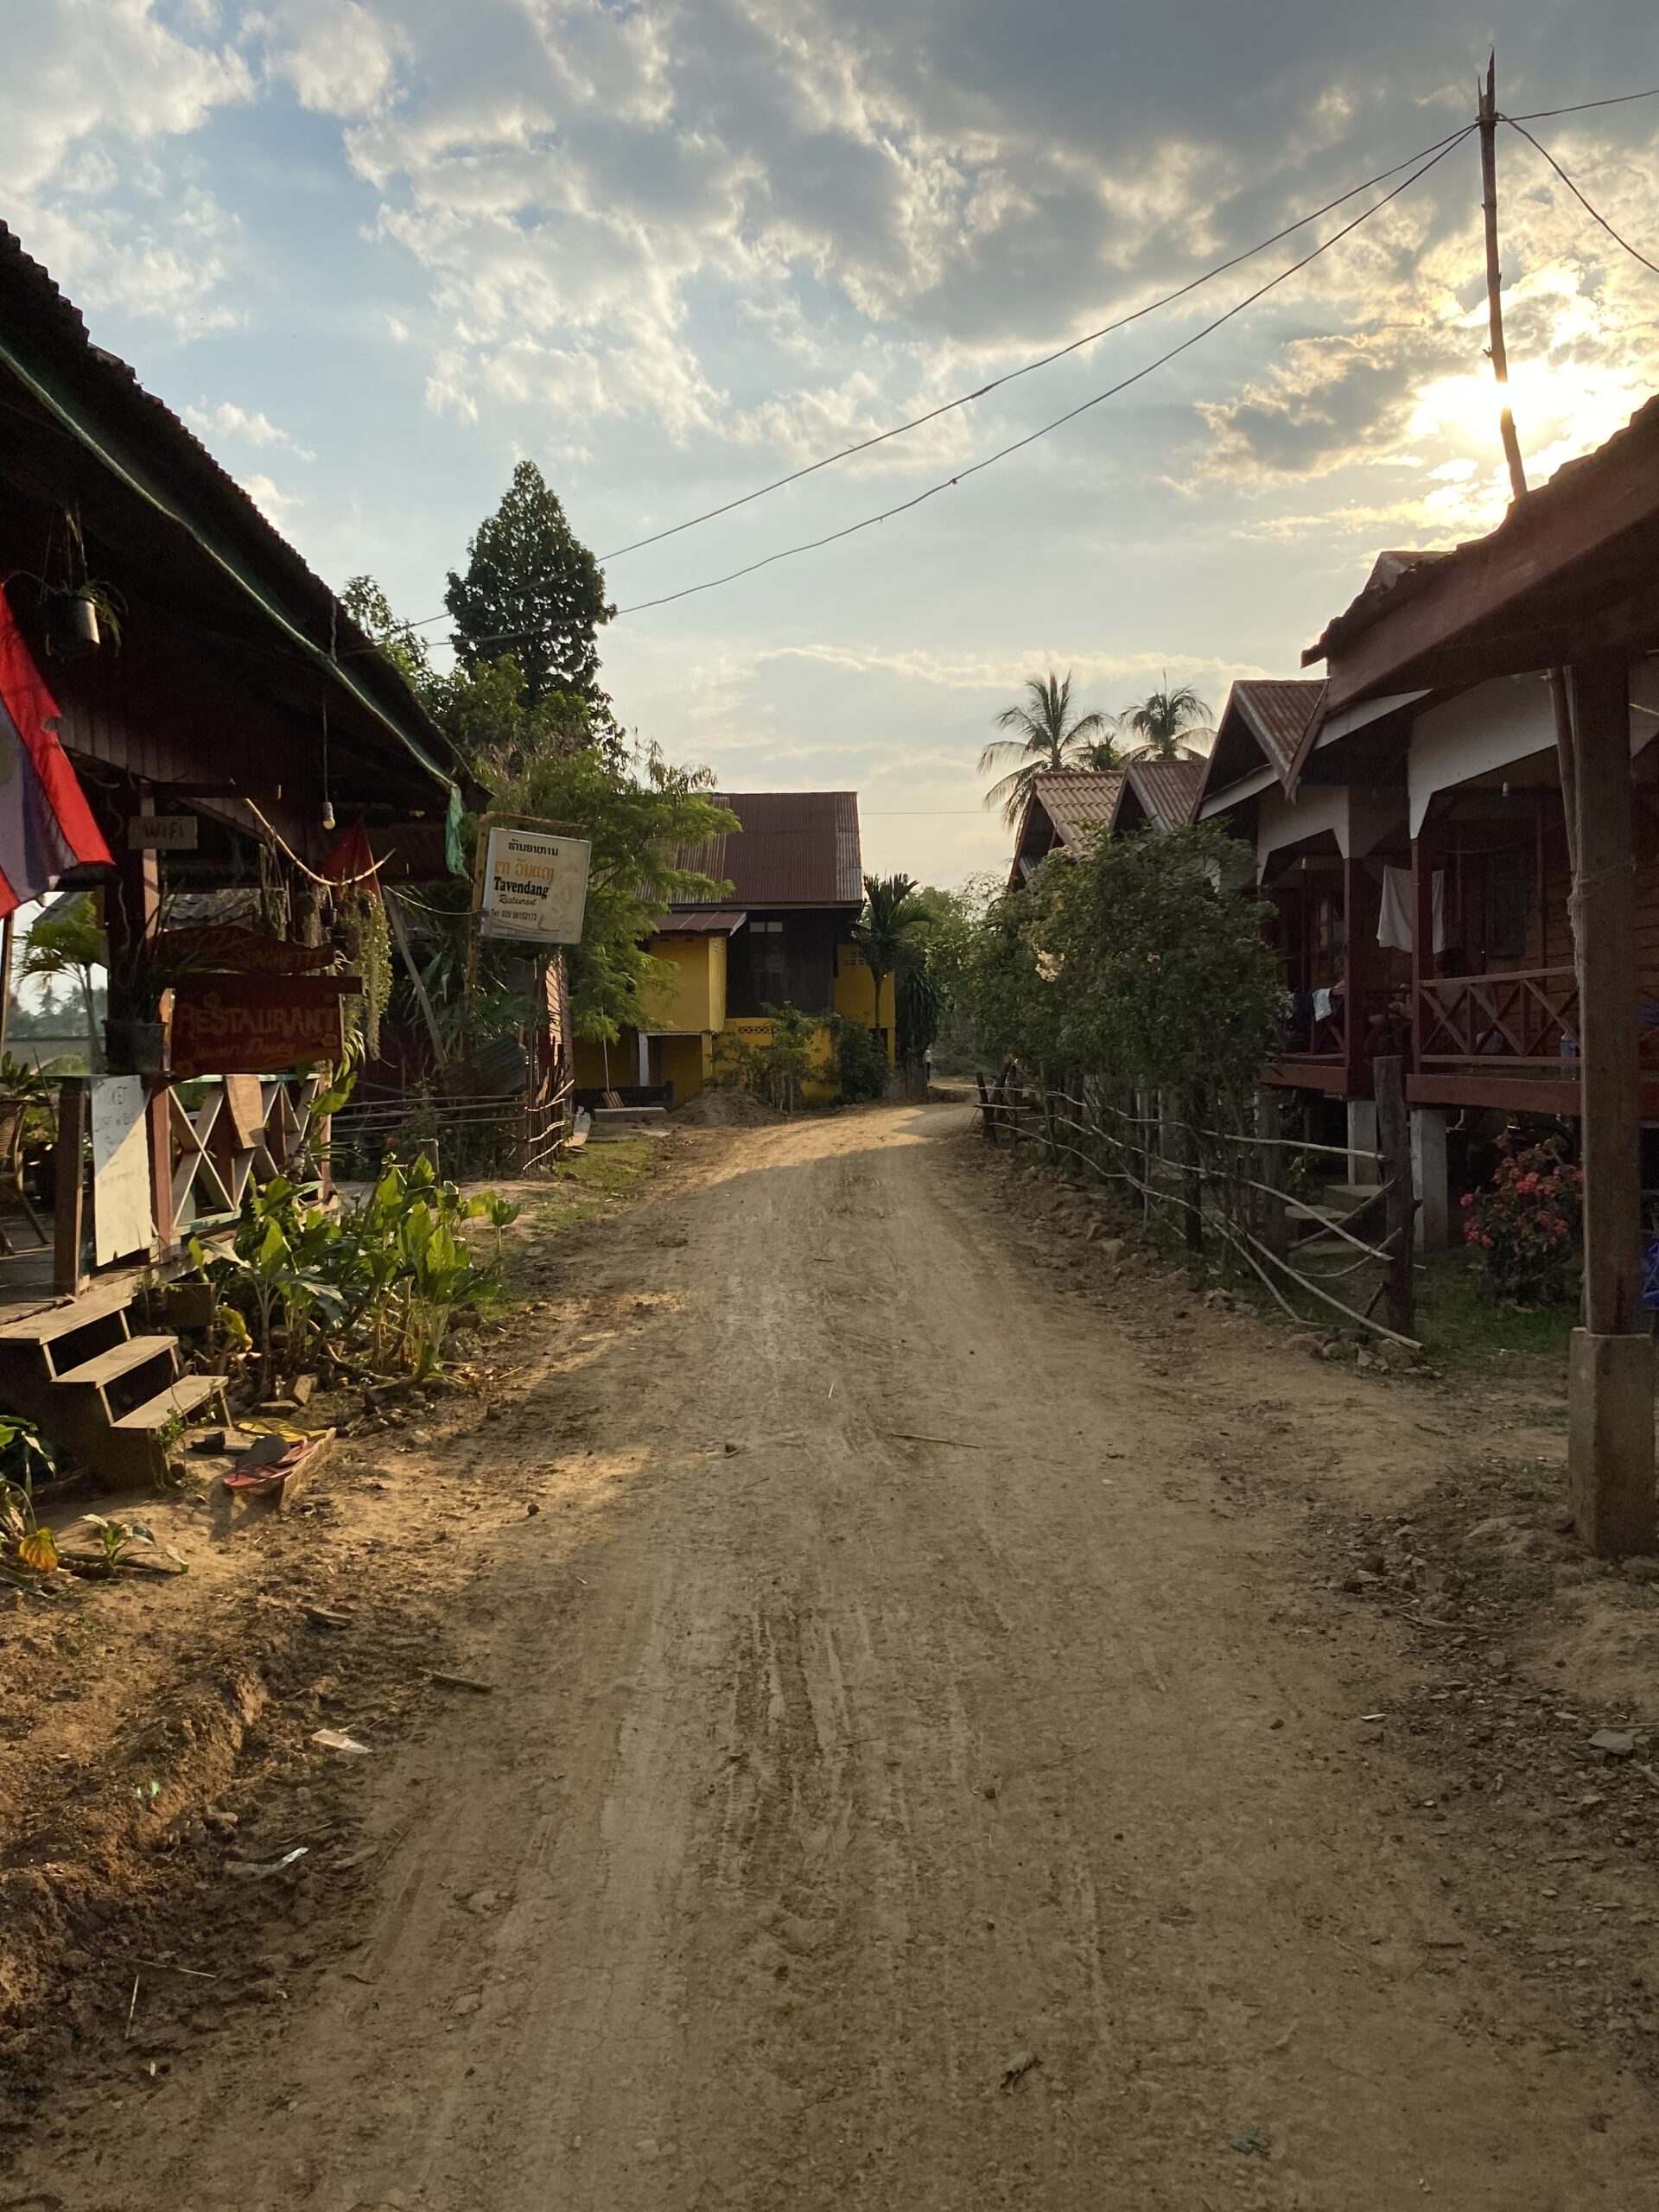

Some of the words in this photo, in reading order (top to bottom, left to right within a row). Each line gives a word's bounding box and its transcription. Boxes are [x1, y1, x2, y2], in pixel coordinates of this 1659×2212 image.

[493, 876, 550, 899] Tavendang
[499, 894, 537, 906] Restaurant
[512, 912, 537, 921] 56152173
[178, 1002, 337, 1039] RESTAURANT
